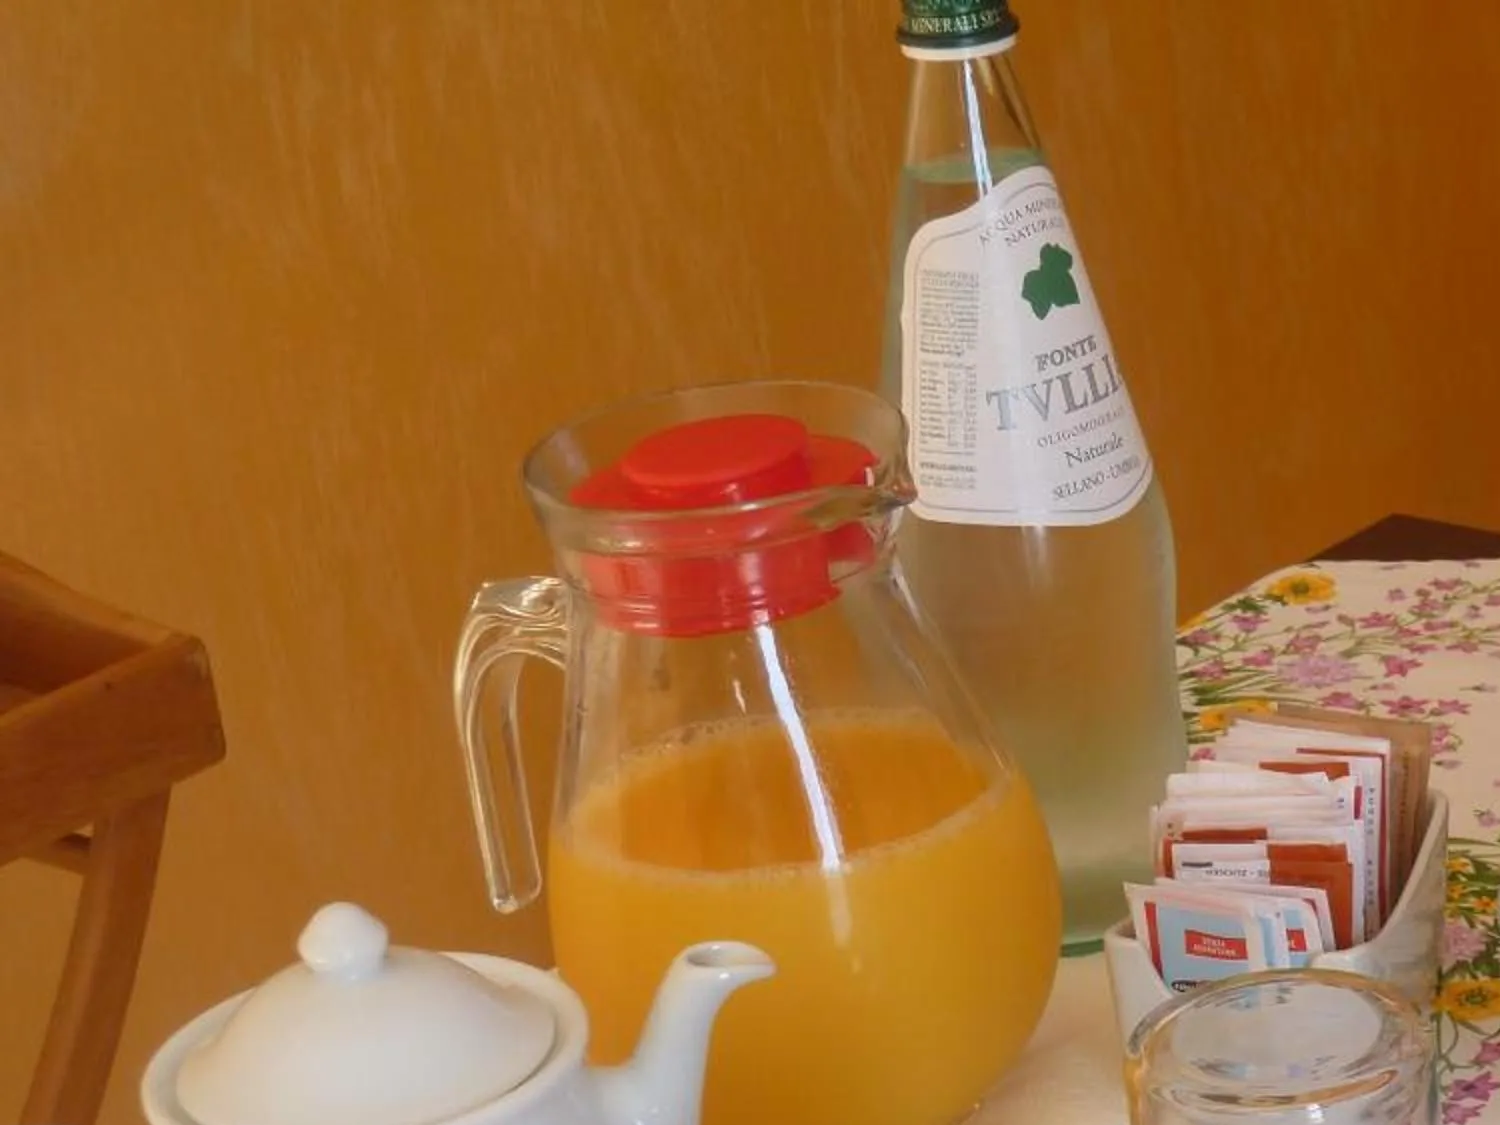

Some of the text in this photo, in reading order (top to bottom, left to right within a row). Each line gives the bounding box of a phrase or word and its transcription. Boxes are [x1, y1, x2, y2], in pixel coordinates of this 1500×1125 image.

[1035, 335, 1097, 371] FONTE
[986, 353, 1123, 430] TVLLI
[1065, 432, 1124, 468] Naturale
